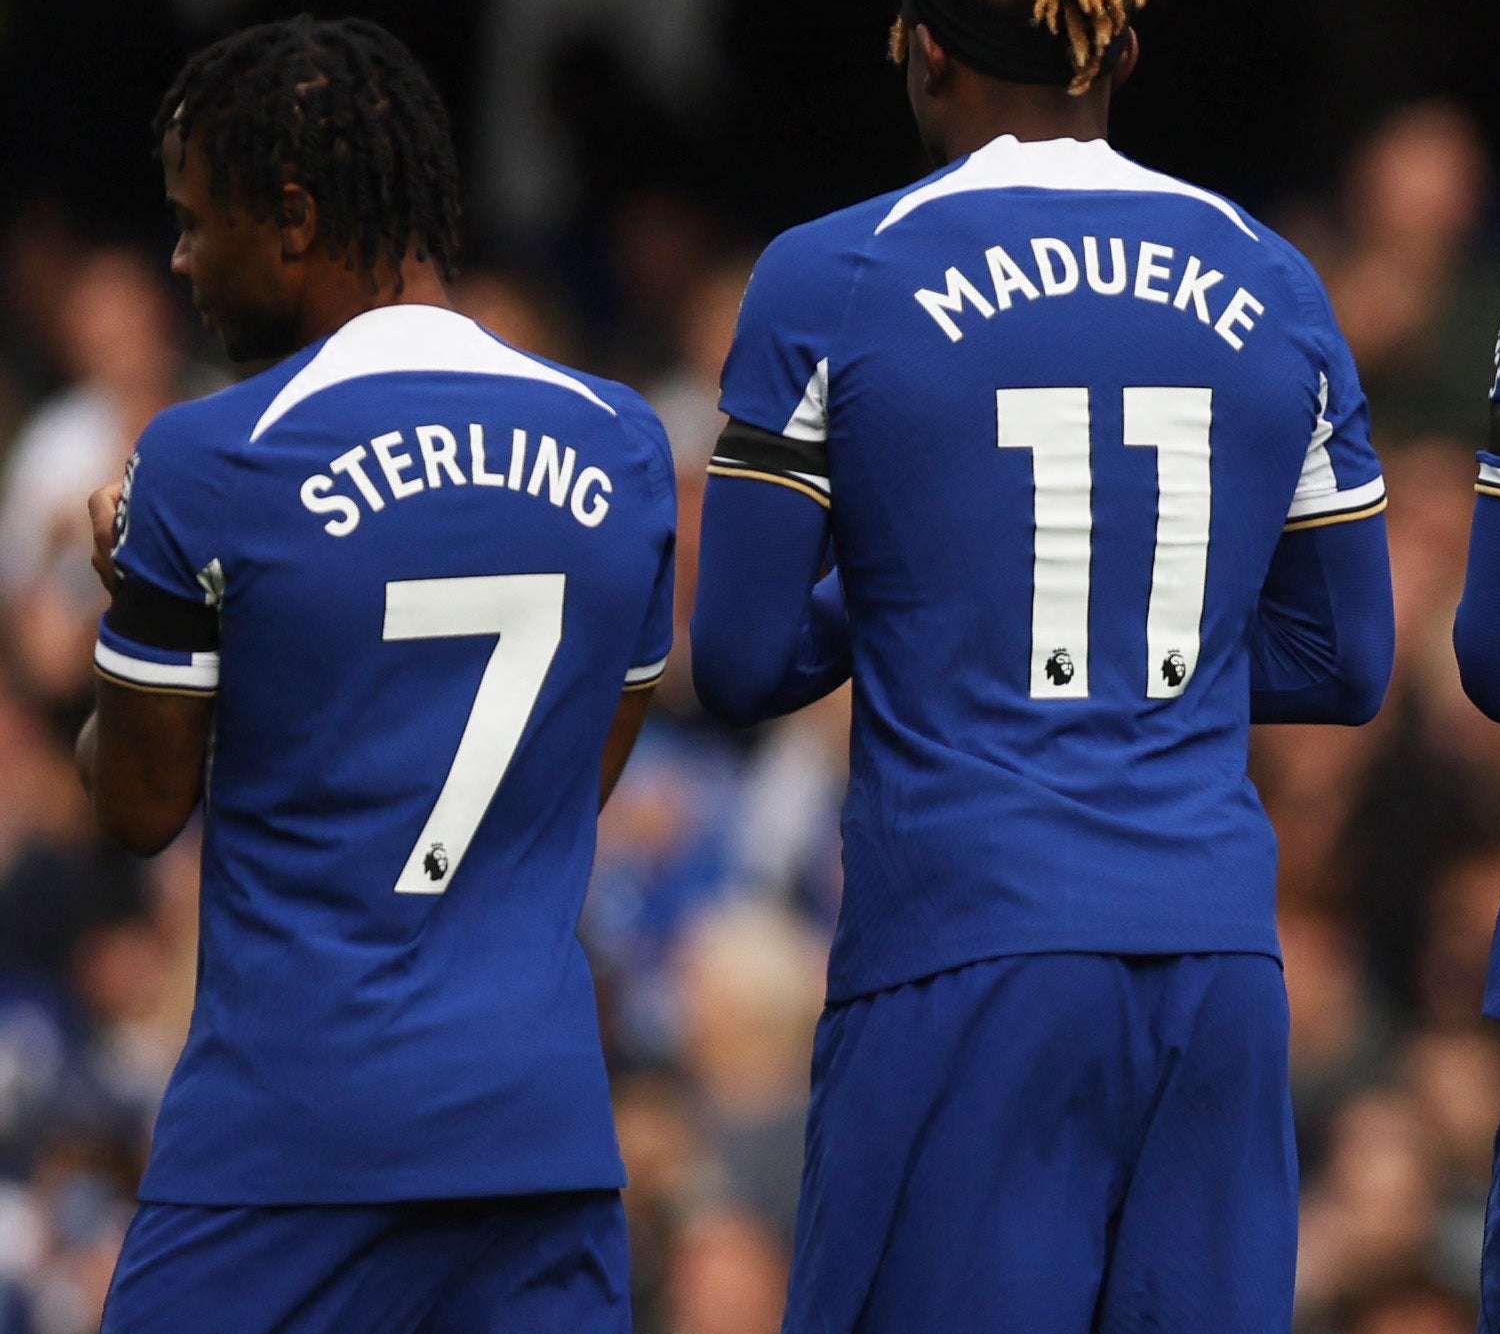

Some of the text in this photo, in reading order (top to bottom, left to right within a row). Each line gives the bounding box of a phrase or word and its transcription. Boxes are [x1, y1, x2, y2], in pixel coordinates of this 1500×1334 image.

[914, 237, 1264, 350] MADUEKE
[300, 423, 613, 537] STERLING
[996, 386, 1213, 699] 11
[382, 573, 566, 894] 7
